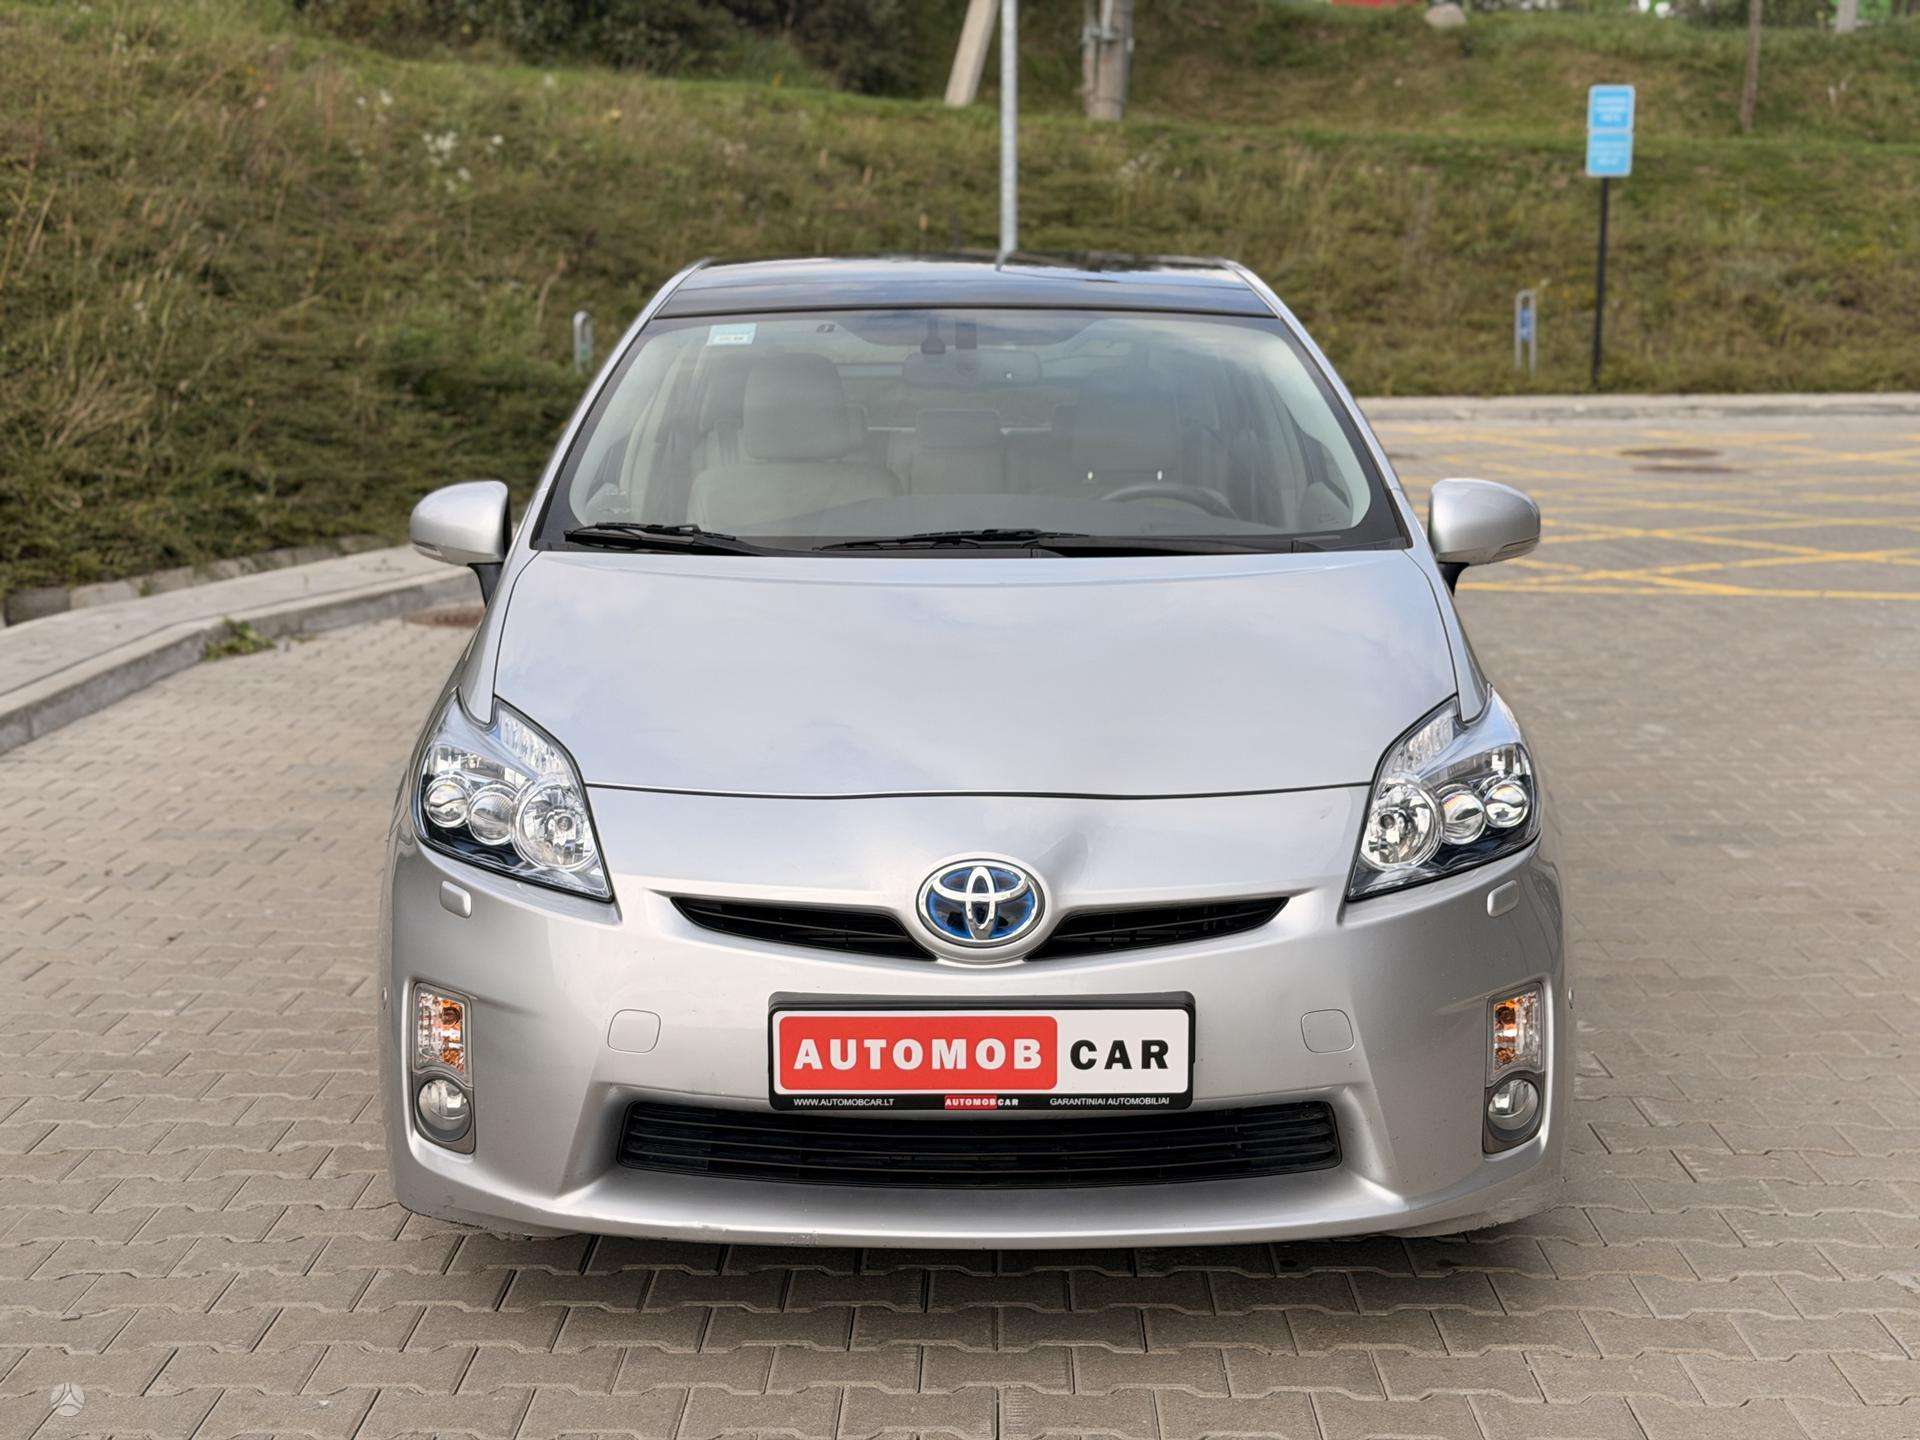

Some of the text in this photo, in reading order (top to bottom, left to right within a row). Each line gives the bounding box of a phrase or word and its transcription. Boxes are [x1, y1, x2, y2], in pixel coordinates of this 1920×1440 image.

[793, 1038, 1169, 1070] AUTOMOB CAR
[793, 1098, 895, 1106] WWW.AUTOMOBCAR.LT
[1049, 1097, 1170, 1106] GARANTINIAI AUTOMOBILIAI
